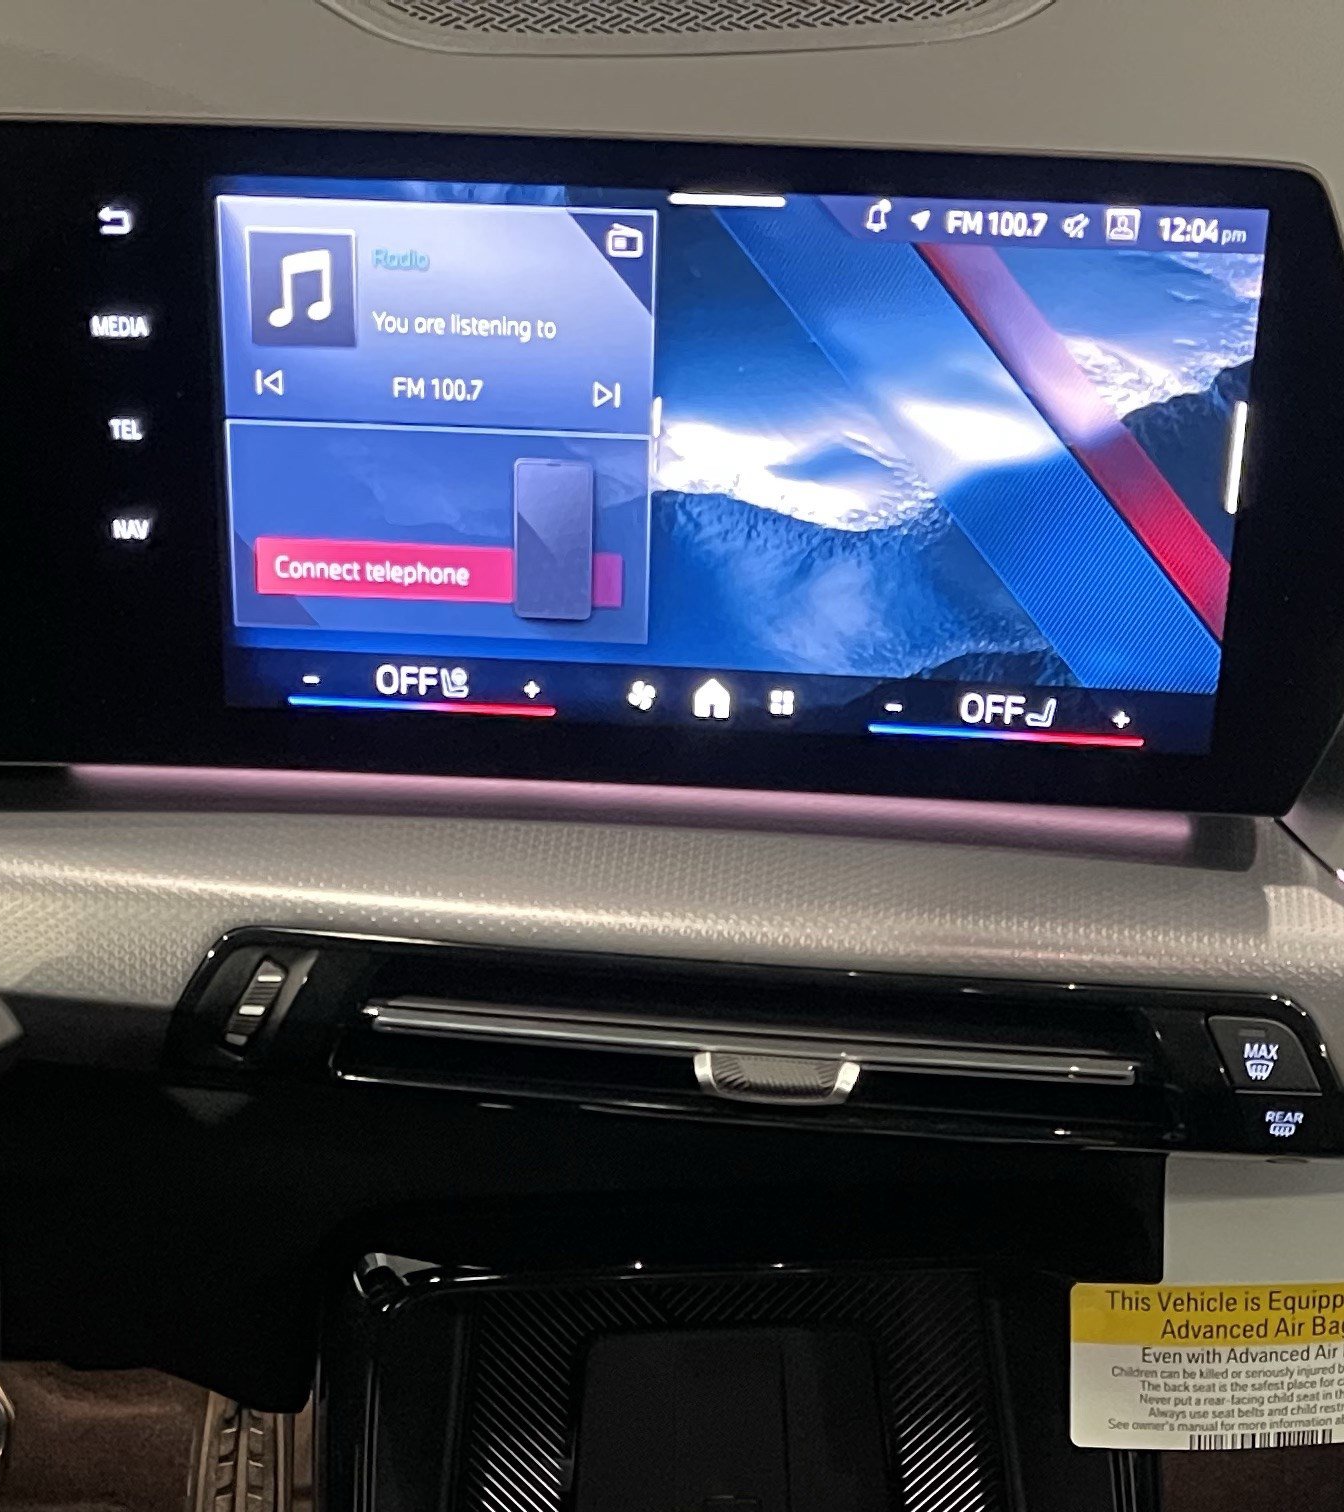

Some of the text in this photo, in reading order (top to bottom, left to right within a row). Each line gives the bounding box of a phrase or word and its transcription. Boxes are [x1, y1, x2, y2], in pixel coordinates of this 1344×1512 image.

[946, 209, 1048, 237] FM 100.7
[371, 247, 430, 271] Radio
[91, 315, 150, 338] MEDIA
[372, 311, 557, 341] You are listening to
[392, 377, 483, 402] FM 100.7
[109, 419, 142, 440] TEL
[112, 519, 150, 540] NAV
[274, 555, 470, 588] Connect telephone
[375, 664, 438, 695] OFF
[959, 693, 1024, 724] OFF
[1243, 1043, 1279, 1060] MAX
[1265, 1110, 1304, 1124] REAR
[1106, 1290, 1151, 1312] This
[1157, 1291, 1238, 1313] Vehicle
[1244, 1291, 1261, 1311] is
[1160, 1318, 1269, 1340] Advanced
[1274, 1316, 1305, 1338] Air
[1142, 1347, 1182, 1364] Even
[1186, 1348, 1222, 1364] with
[1226, 1346, 1310, 1364] Advanced
[1314, 1344, 1338, 1360] Air
[1111, 1365, 1157, 1379] Children
[1160, 1369, 1180, 1379] can
[1182, 1368, 1196, 1380] be
[1199, 1368, 1229, 1380] killed
[1231, 1370, 1242, 1379] or
[1297, 1363, 1336, 1379] injured
[1140, 1380, 1161, 1392] The
[1163, 1380, 1190, 1393] back
[1192, 1381, 1216, 1392] seat
[1218, 1381, 1228, 1392] is
[1230, 1381, 1248, 1392] the
[1251, 1379, 1285, 1392] safest
[1287, 1377, 1317, 1391] place
[1319, 1376, 1335, 1388] for
[1174, 1394, 1193, 1407] put
[1267, 1391, 1294, 1404] child
[1296, 1390, 1320, 1402] seat
[1322, 1389, 1333, 1400] in
[1189, 1409, 1209, 1419] use
[1211, 1408, 1235, 1419] seat
[1238, 1407, 1265, 1418] belts
[1267, 1405, 1288, 1417] and
[1290, 1403, 1317, 1415] child
[1108, 1418, 1130, 1430] See
[1177, 1419, 1218, 1432] manual
[1220, 1420, 1236, 1431] for
[1238, 1421, 1267, 1431] more
[1269, 1416, 1333, 1429] information
